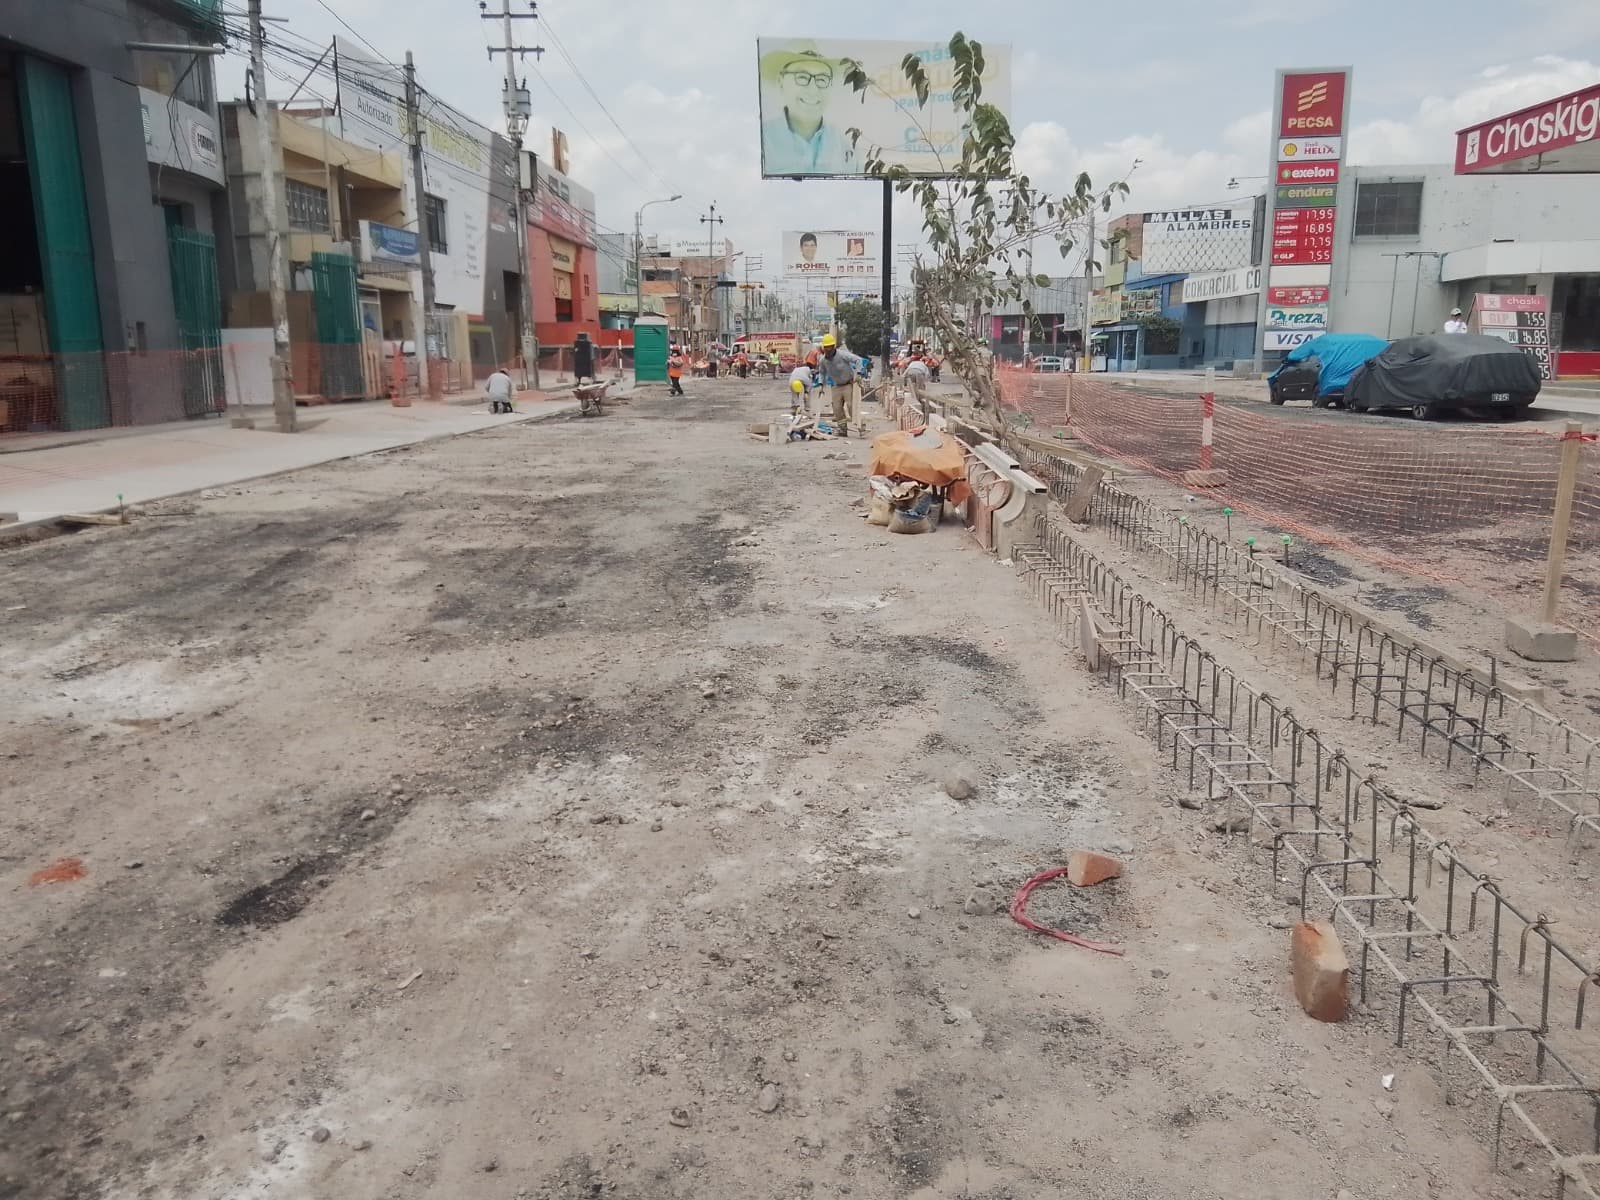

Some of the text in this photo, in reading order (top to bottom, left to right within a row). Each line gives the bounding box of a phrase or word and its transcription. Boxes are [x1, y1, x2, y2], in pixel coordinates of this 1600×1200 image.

[357, 96, 393, 126] Autorizado
[1287, 116, 1334, 129] PECSA
[1486, 96, 1600, 158] Chaskig
[1304, 144, 1336, 155] HELIX
[1291, 166, 1335, 178] exelon
[1287, 186, 1334, 198] endura
[1150, 210, 1226, 223] MALLAS
[1306, 209, 1334, 221] 17.95
[1167, 219, 1252, 232] ALAMBRES
[1305, 223, 1332, 235] 16.85
[1304, 236, 1332, 248] 17.75
[1309, 250, 1330, 262] 7.55
[1184, 274, 1239, 298] COMERCIAL
[1506, 296, 1541, 305] chaski
[1523, 311, 1545, 327] 7.55
[1522, 330, 1547, 345] 16.85
